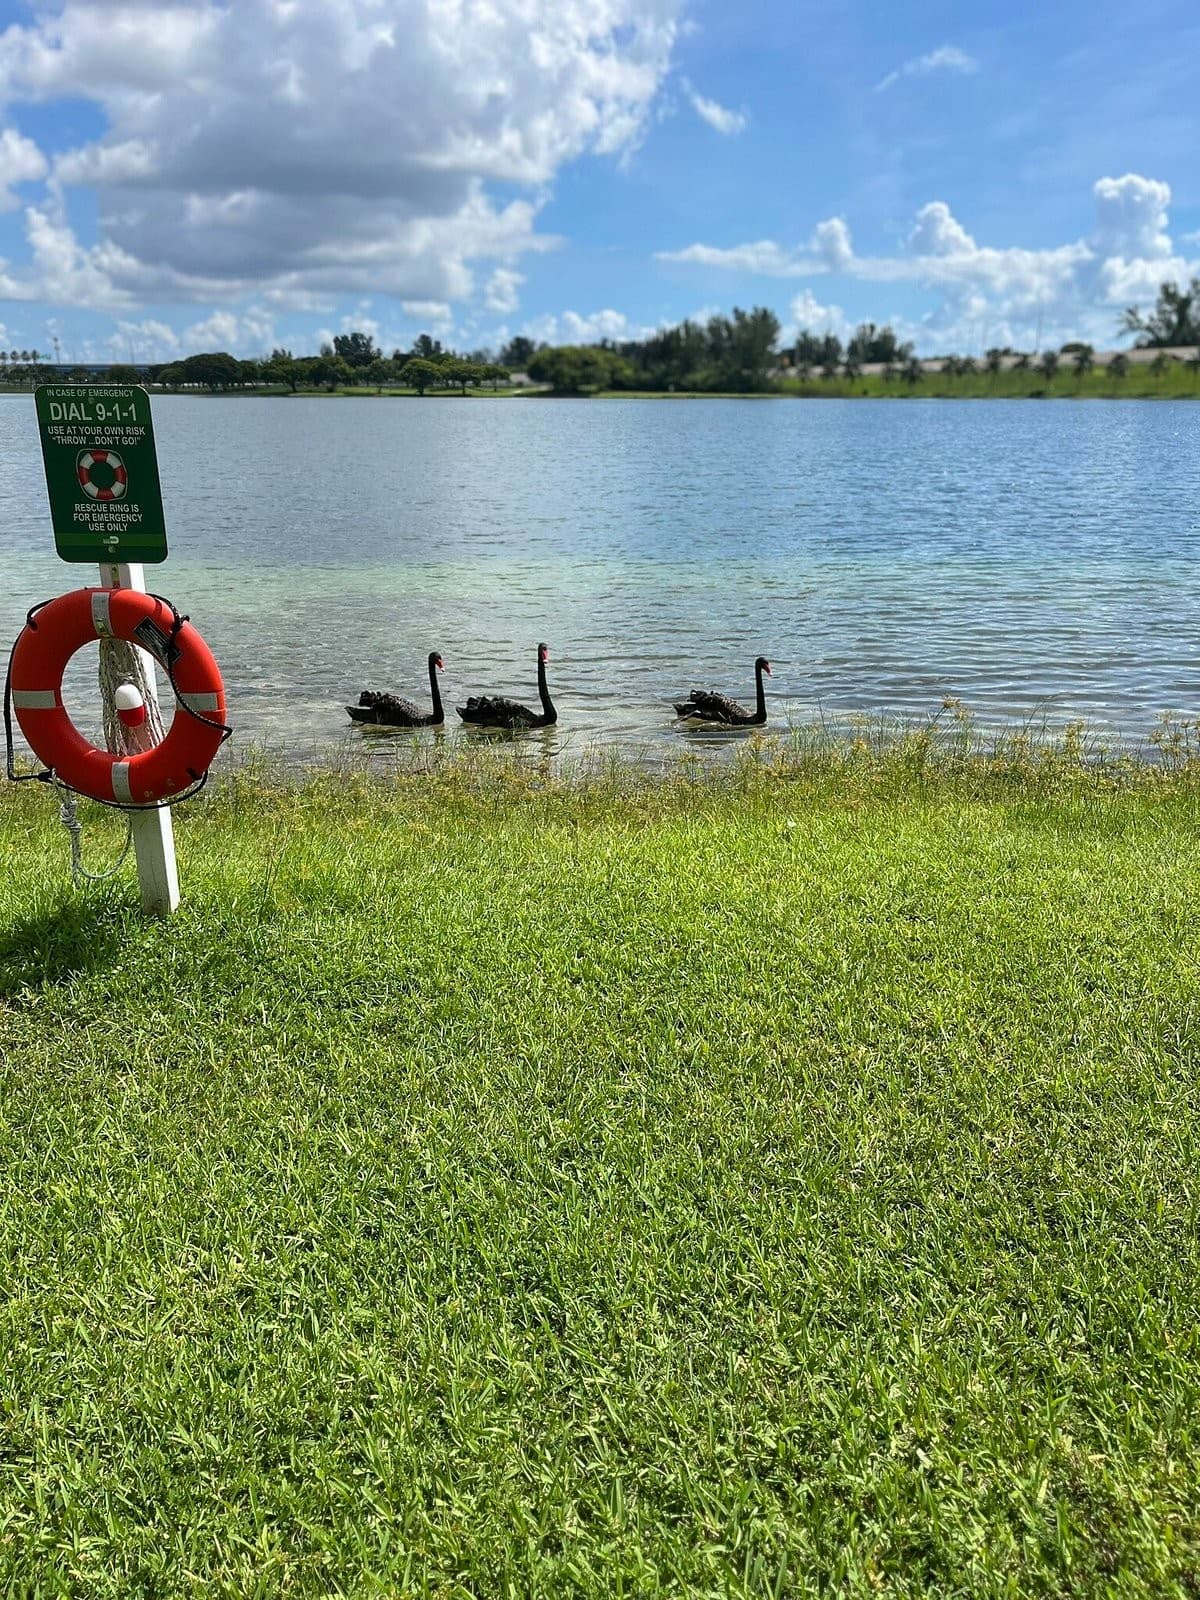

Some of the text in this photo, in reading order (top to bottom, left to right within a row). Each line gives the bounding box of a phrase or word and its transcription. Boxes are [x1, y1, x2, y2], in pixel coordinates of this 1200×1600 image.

[88, 389, 134, 397] EMERGENCY
[50, 402, 136, 421] DIAL 9-1-1
[48, 426, 146, 435] USE AT YOUR OWN RISK
[74, 504, 139, 512] RESCUE RING IS
[92, 514, 143, 522] EMERGENCY
[107, 523, 128, 531] ONLY
